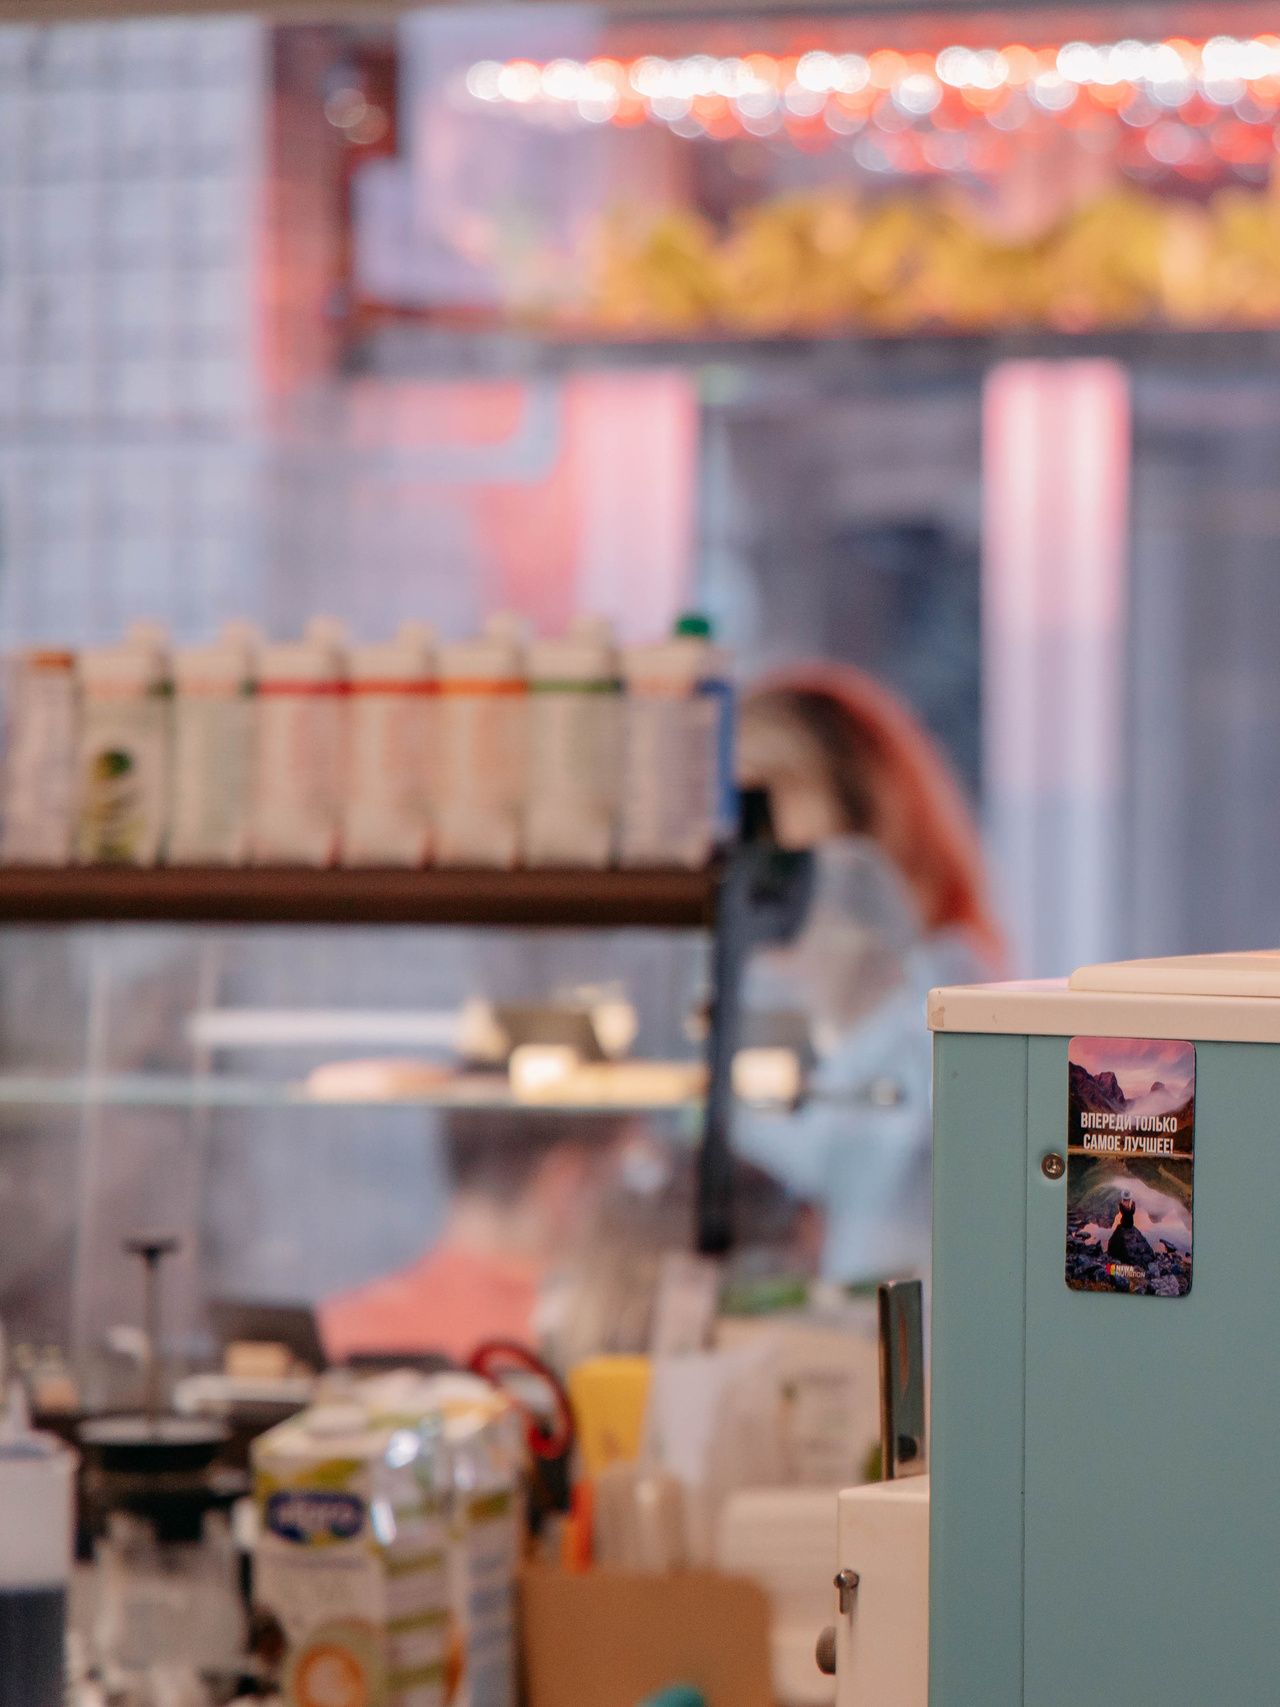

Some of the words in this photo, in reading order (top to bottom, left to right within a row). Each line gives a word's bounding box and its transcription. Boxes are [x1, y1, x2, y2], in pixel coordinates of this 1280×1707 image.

[1080, 1112, 1132, 1132] ВПЕРЕДИ
[1134, 1115, 1178, 1133] ТОЛЬКО
[1083, 1133, 1121, 1151] САМОЕ
[1123, 1136, 1174, 1154] ЛУЧШЕЕ!
